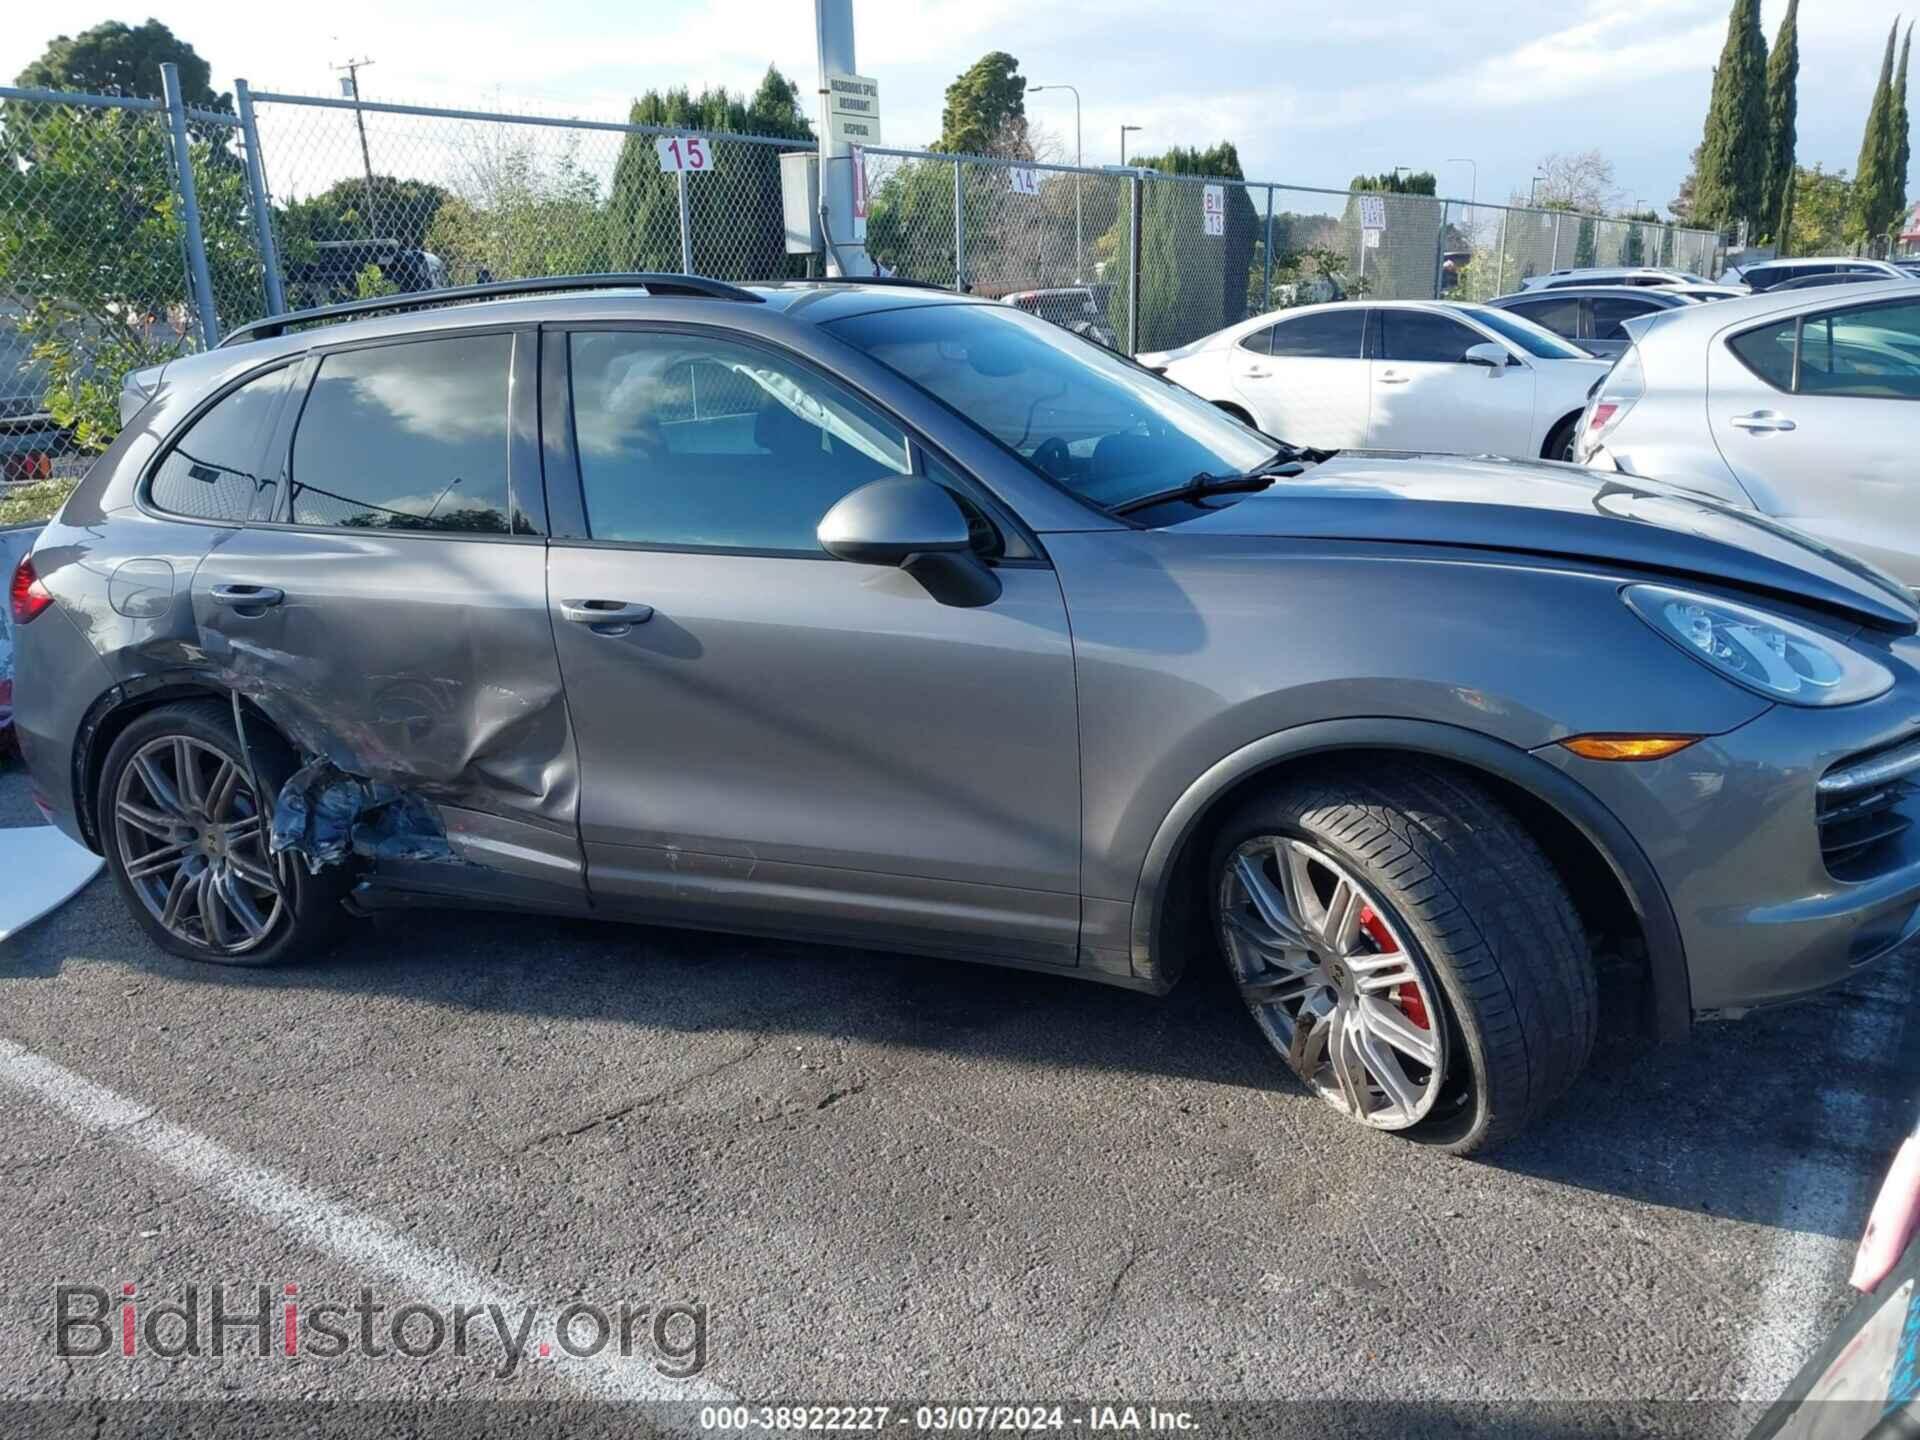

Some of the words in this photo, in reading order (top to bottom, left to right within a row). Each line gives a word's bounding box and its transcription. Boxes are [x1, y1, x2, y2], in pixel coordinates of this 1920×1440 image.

[668, 139, 704, 169] 15
[1016, 170, 1035, 192] 14
[1209, 215, 1221, 232] 13
